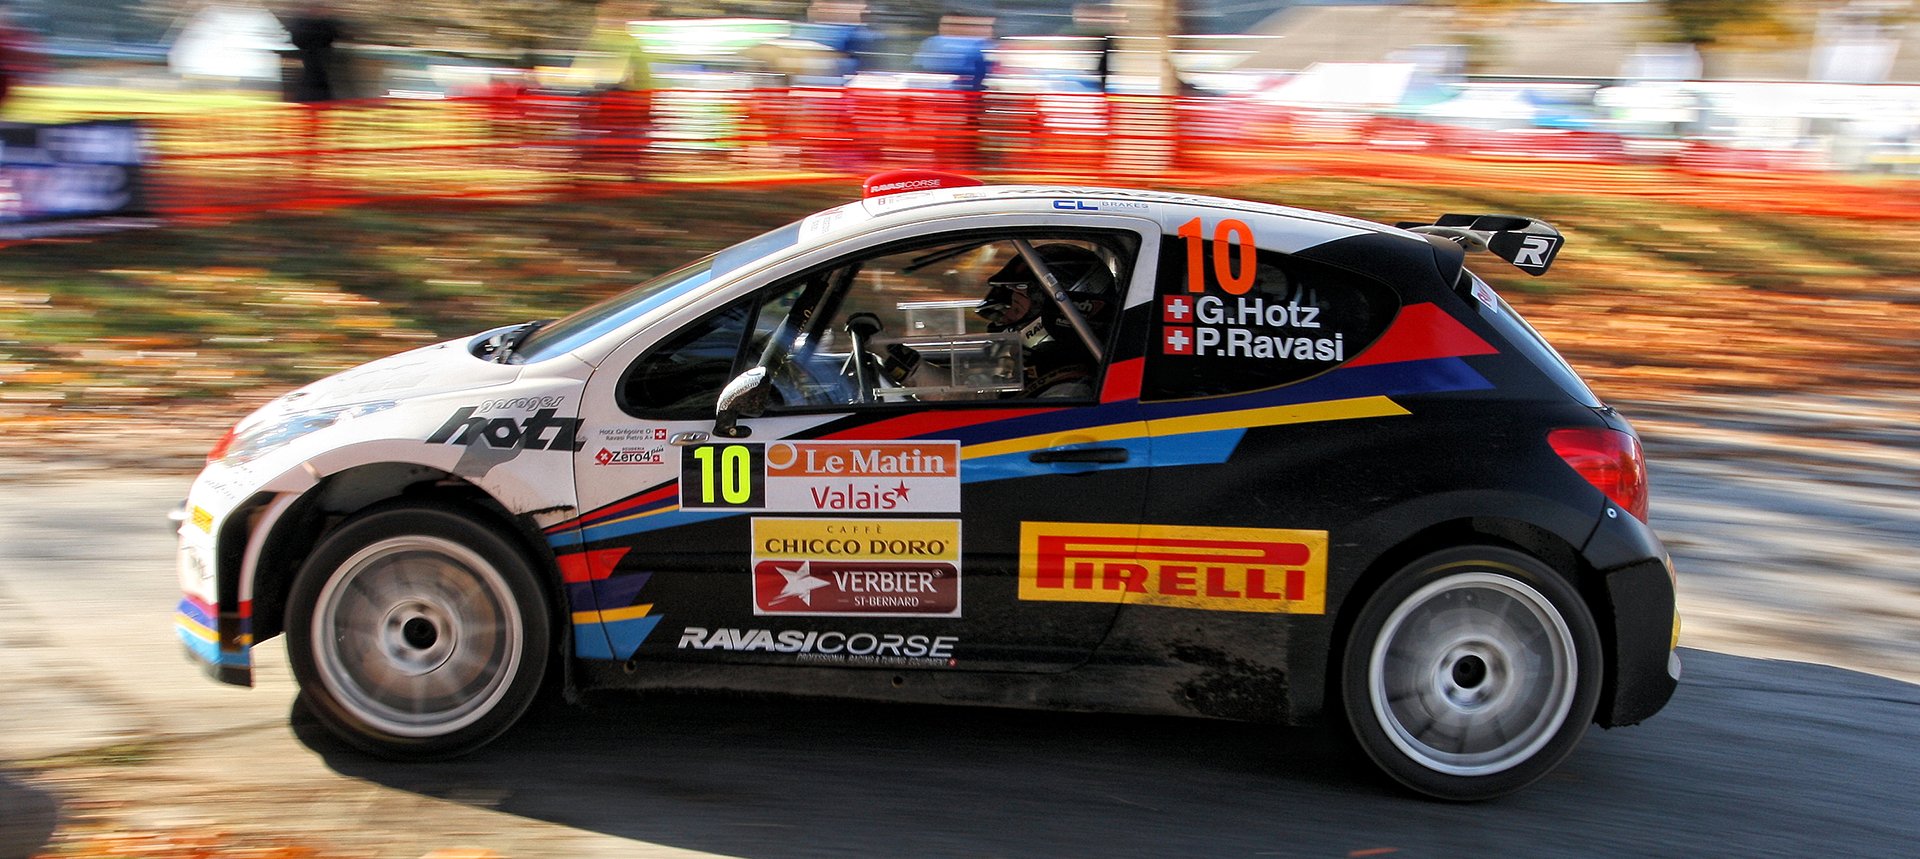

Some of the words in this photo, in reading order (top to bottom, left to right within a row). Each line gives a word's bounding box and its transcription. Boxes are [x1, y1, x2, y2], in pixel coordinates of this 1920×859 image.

[1053, 200, 1099, 210] CL
[1102, 201, 1149, 209] BRAKES
[1178, 217, 1257, 295] 10
[1514, 237, 1549, 265] R
[1196, 295, 1321, 329] G.Hotz
[1196, 327, 1344, 362] P.Ravasi
[480, 396, 565, 413] garages
[425, 406, 586, 452] hotz
[694, 445, 751, 504] 10
[804, 449, 844, 474] Le
[849, 449, 947, 474] Matin
[810, 484, 897, 510] Valais
[827, 524, 883, 535] CAFFÈ
[765, 538, 861, 555] CHICCO
[870, 540, 945, 555] D'ORO
[1036, 535, 1311, 601] PIRELLI
[854, 596, 919, 607] ST-BERNARD
[678, 627, 959, 658] RAVASICORSE
